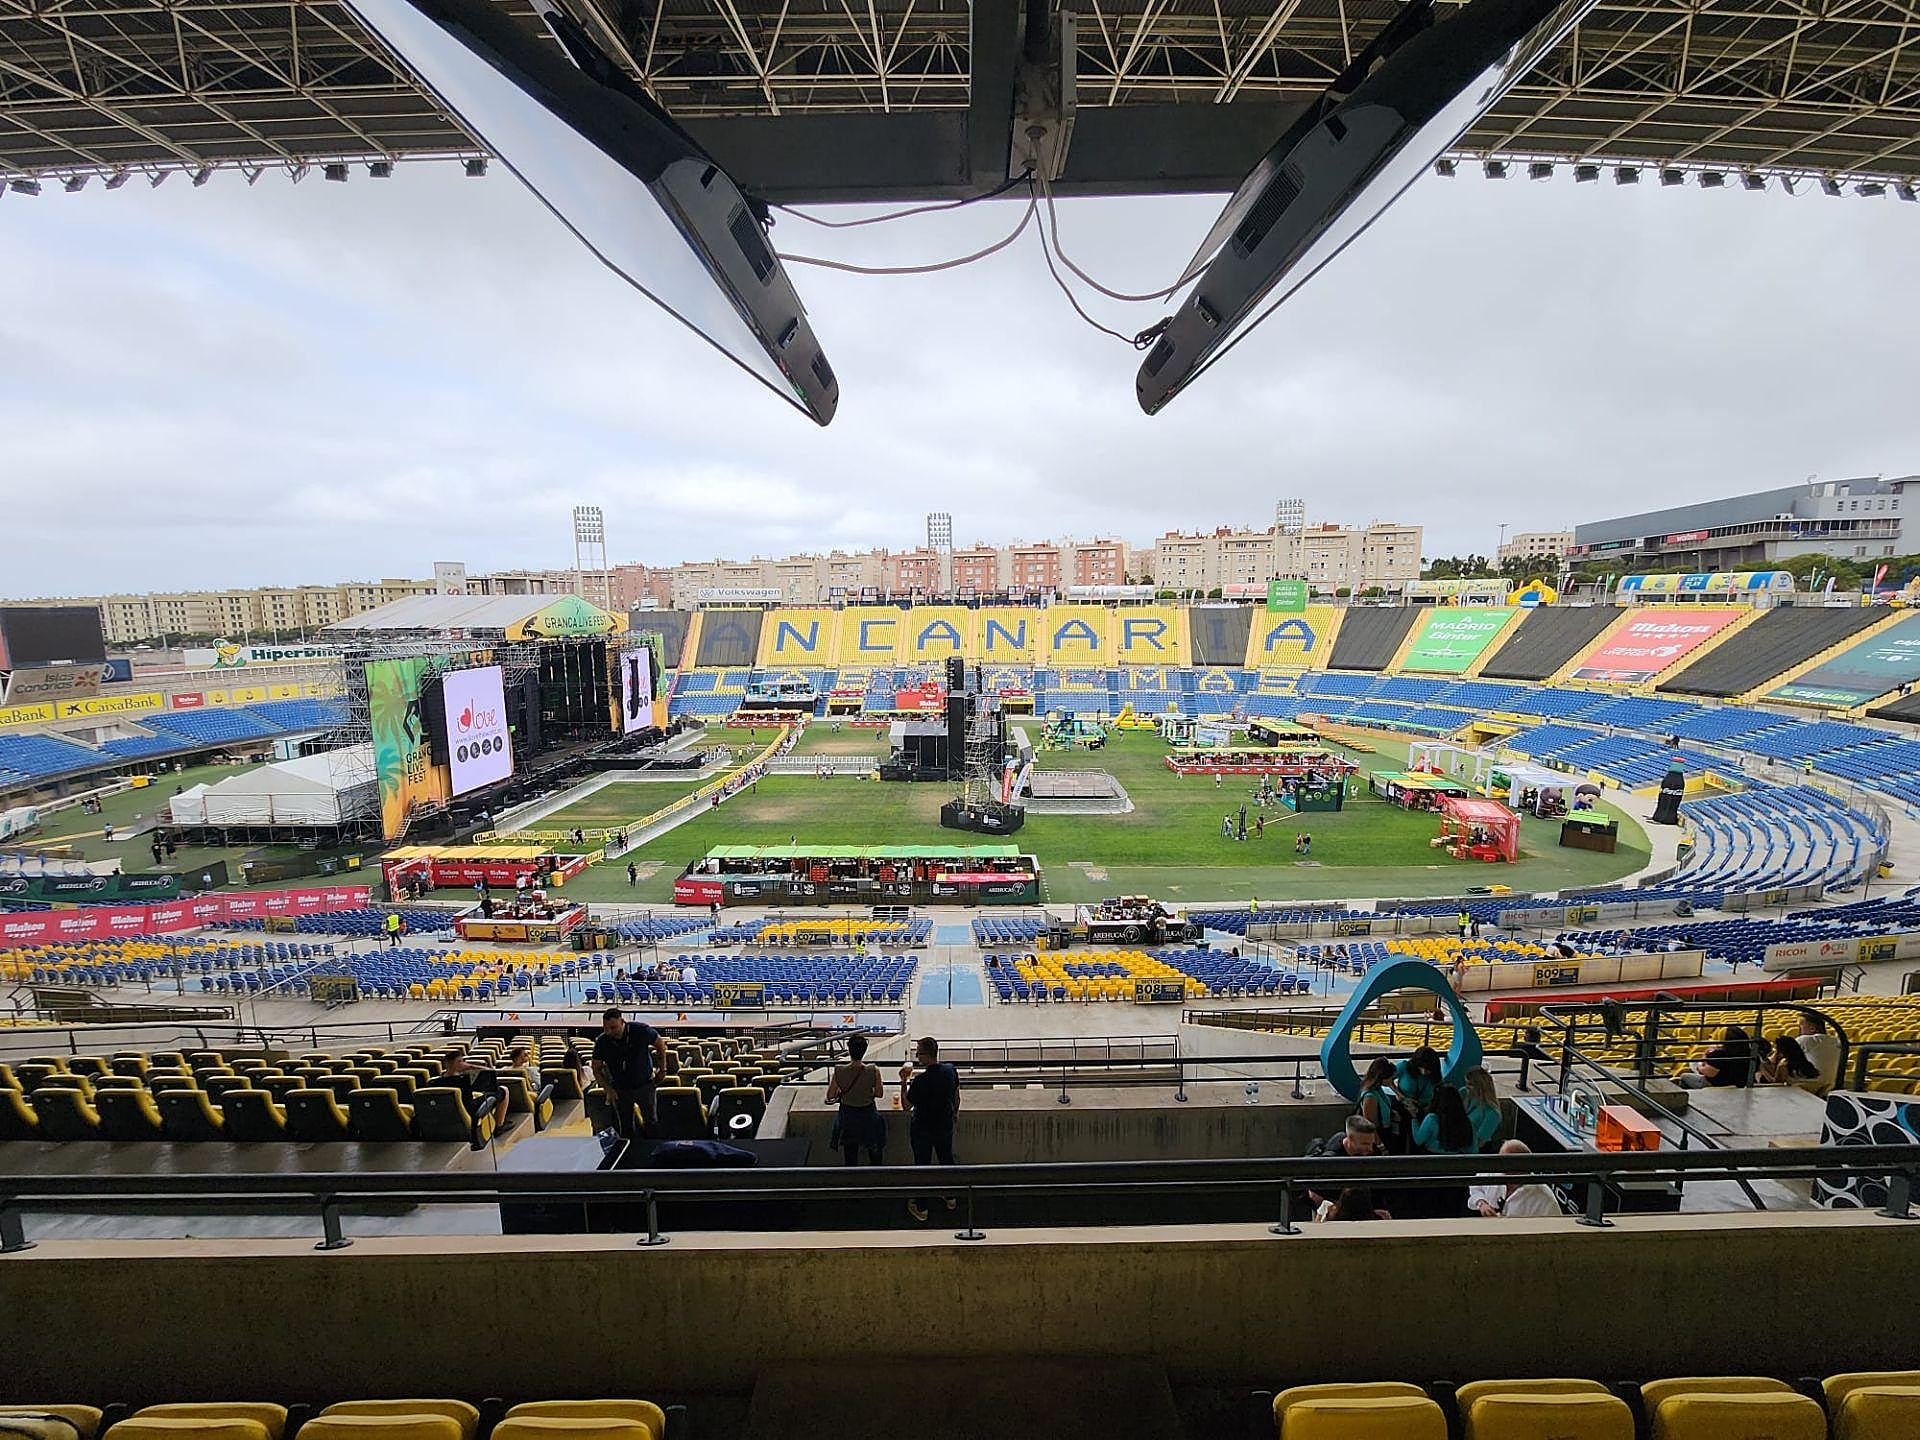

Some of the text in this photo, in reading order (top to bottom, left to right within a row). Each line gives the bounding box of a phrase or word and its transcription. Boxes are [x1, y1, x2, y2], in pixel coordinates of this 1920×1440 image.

[717, 588, 780, 598] Volkswagen
[544, 615, 608, 629] GRANCA LIVE FEST
[1429, 622, 1497, 631] MADRID
[1628, 622, 1713, 634] Mahou
[1428, 631, 1483, 641] Binter
[251, 647, 344, 662] HiperDino
[45, 672, 75, 684] Islas
[14, 682, 73, 695] Canarias
[85, 696, 157, 713] CaixaBank
[407, 760, 425, 775] LIVE
[408, 769, 427, 787] FEST
[1775, 947, 1807, 957] RICOH
[714, 989, 739, 999] B07
[1136, 984, 1161, 995] B08
